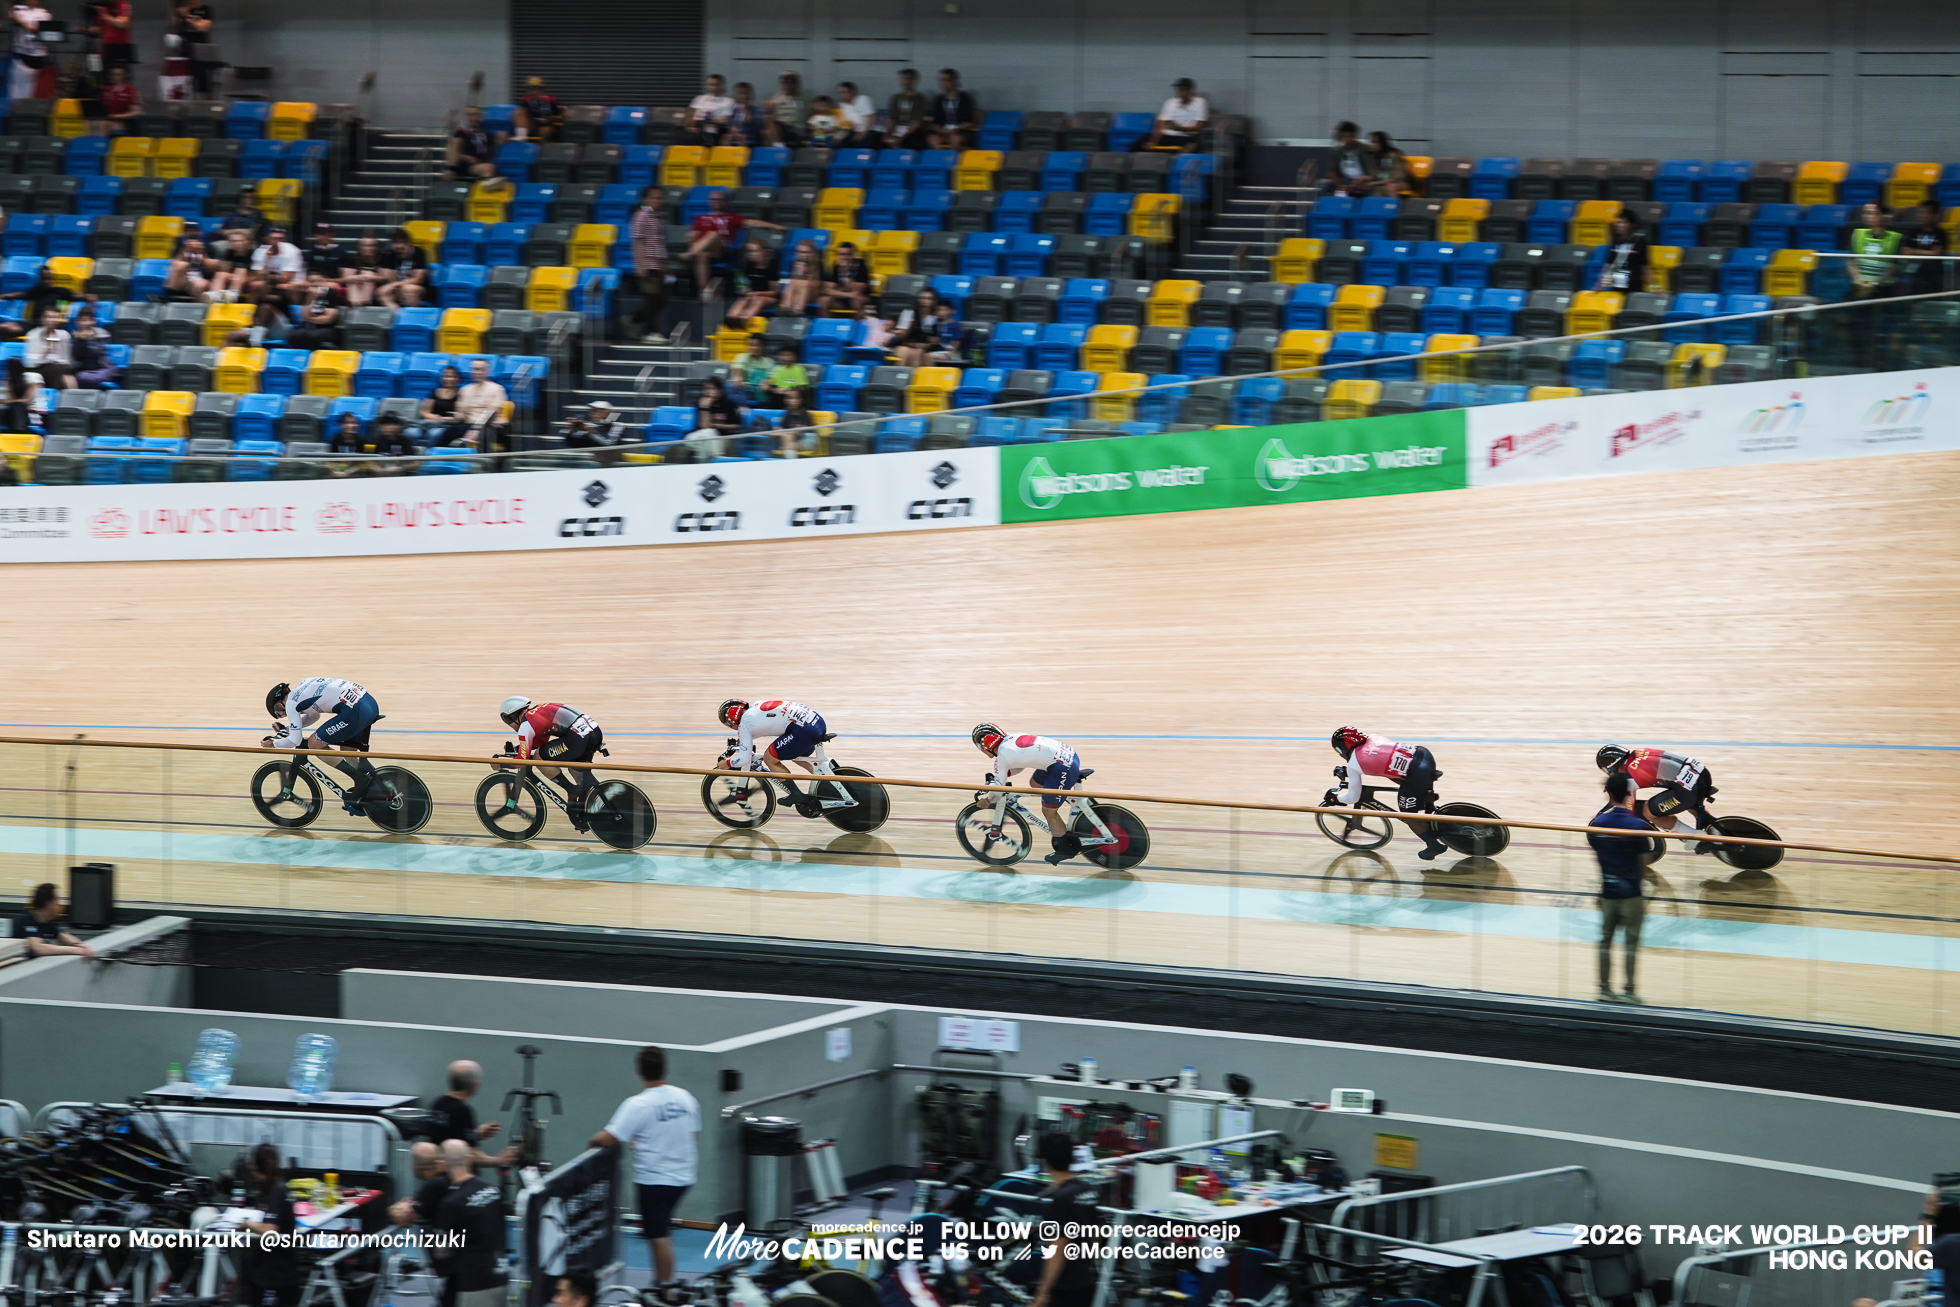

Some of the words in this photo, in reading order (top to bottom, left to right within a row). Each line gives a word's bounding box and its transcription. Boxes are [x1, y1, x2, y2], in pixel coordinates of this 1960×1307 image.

[1372, 445, 1448, 469] water
[1134, 465, 1210, 488] water
[138, 507, 214, 535] LAW'S
[220, 506, 298, 533] CYCLE
[366, 501, 445, 529] LAW'S
[449, 498, 526, 526] CYCLE
[343, 688, 358, 704] 130
[325, 720, 349, 736] ISRAEL
[548, 741, 569, 758] CHINA
[1393, 756, 1408, 771] 170
[304, 761, 343, 798] KOGA
[1681, 769, 1694, 784] 79
[536, 780, 569, 812] KOGA
[1657, 796, 1681, 813] CHINA
